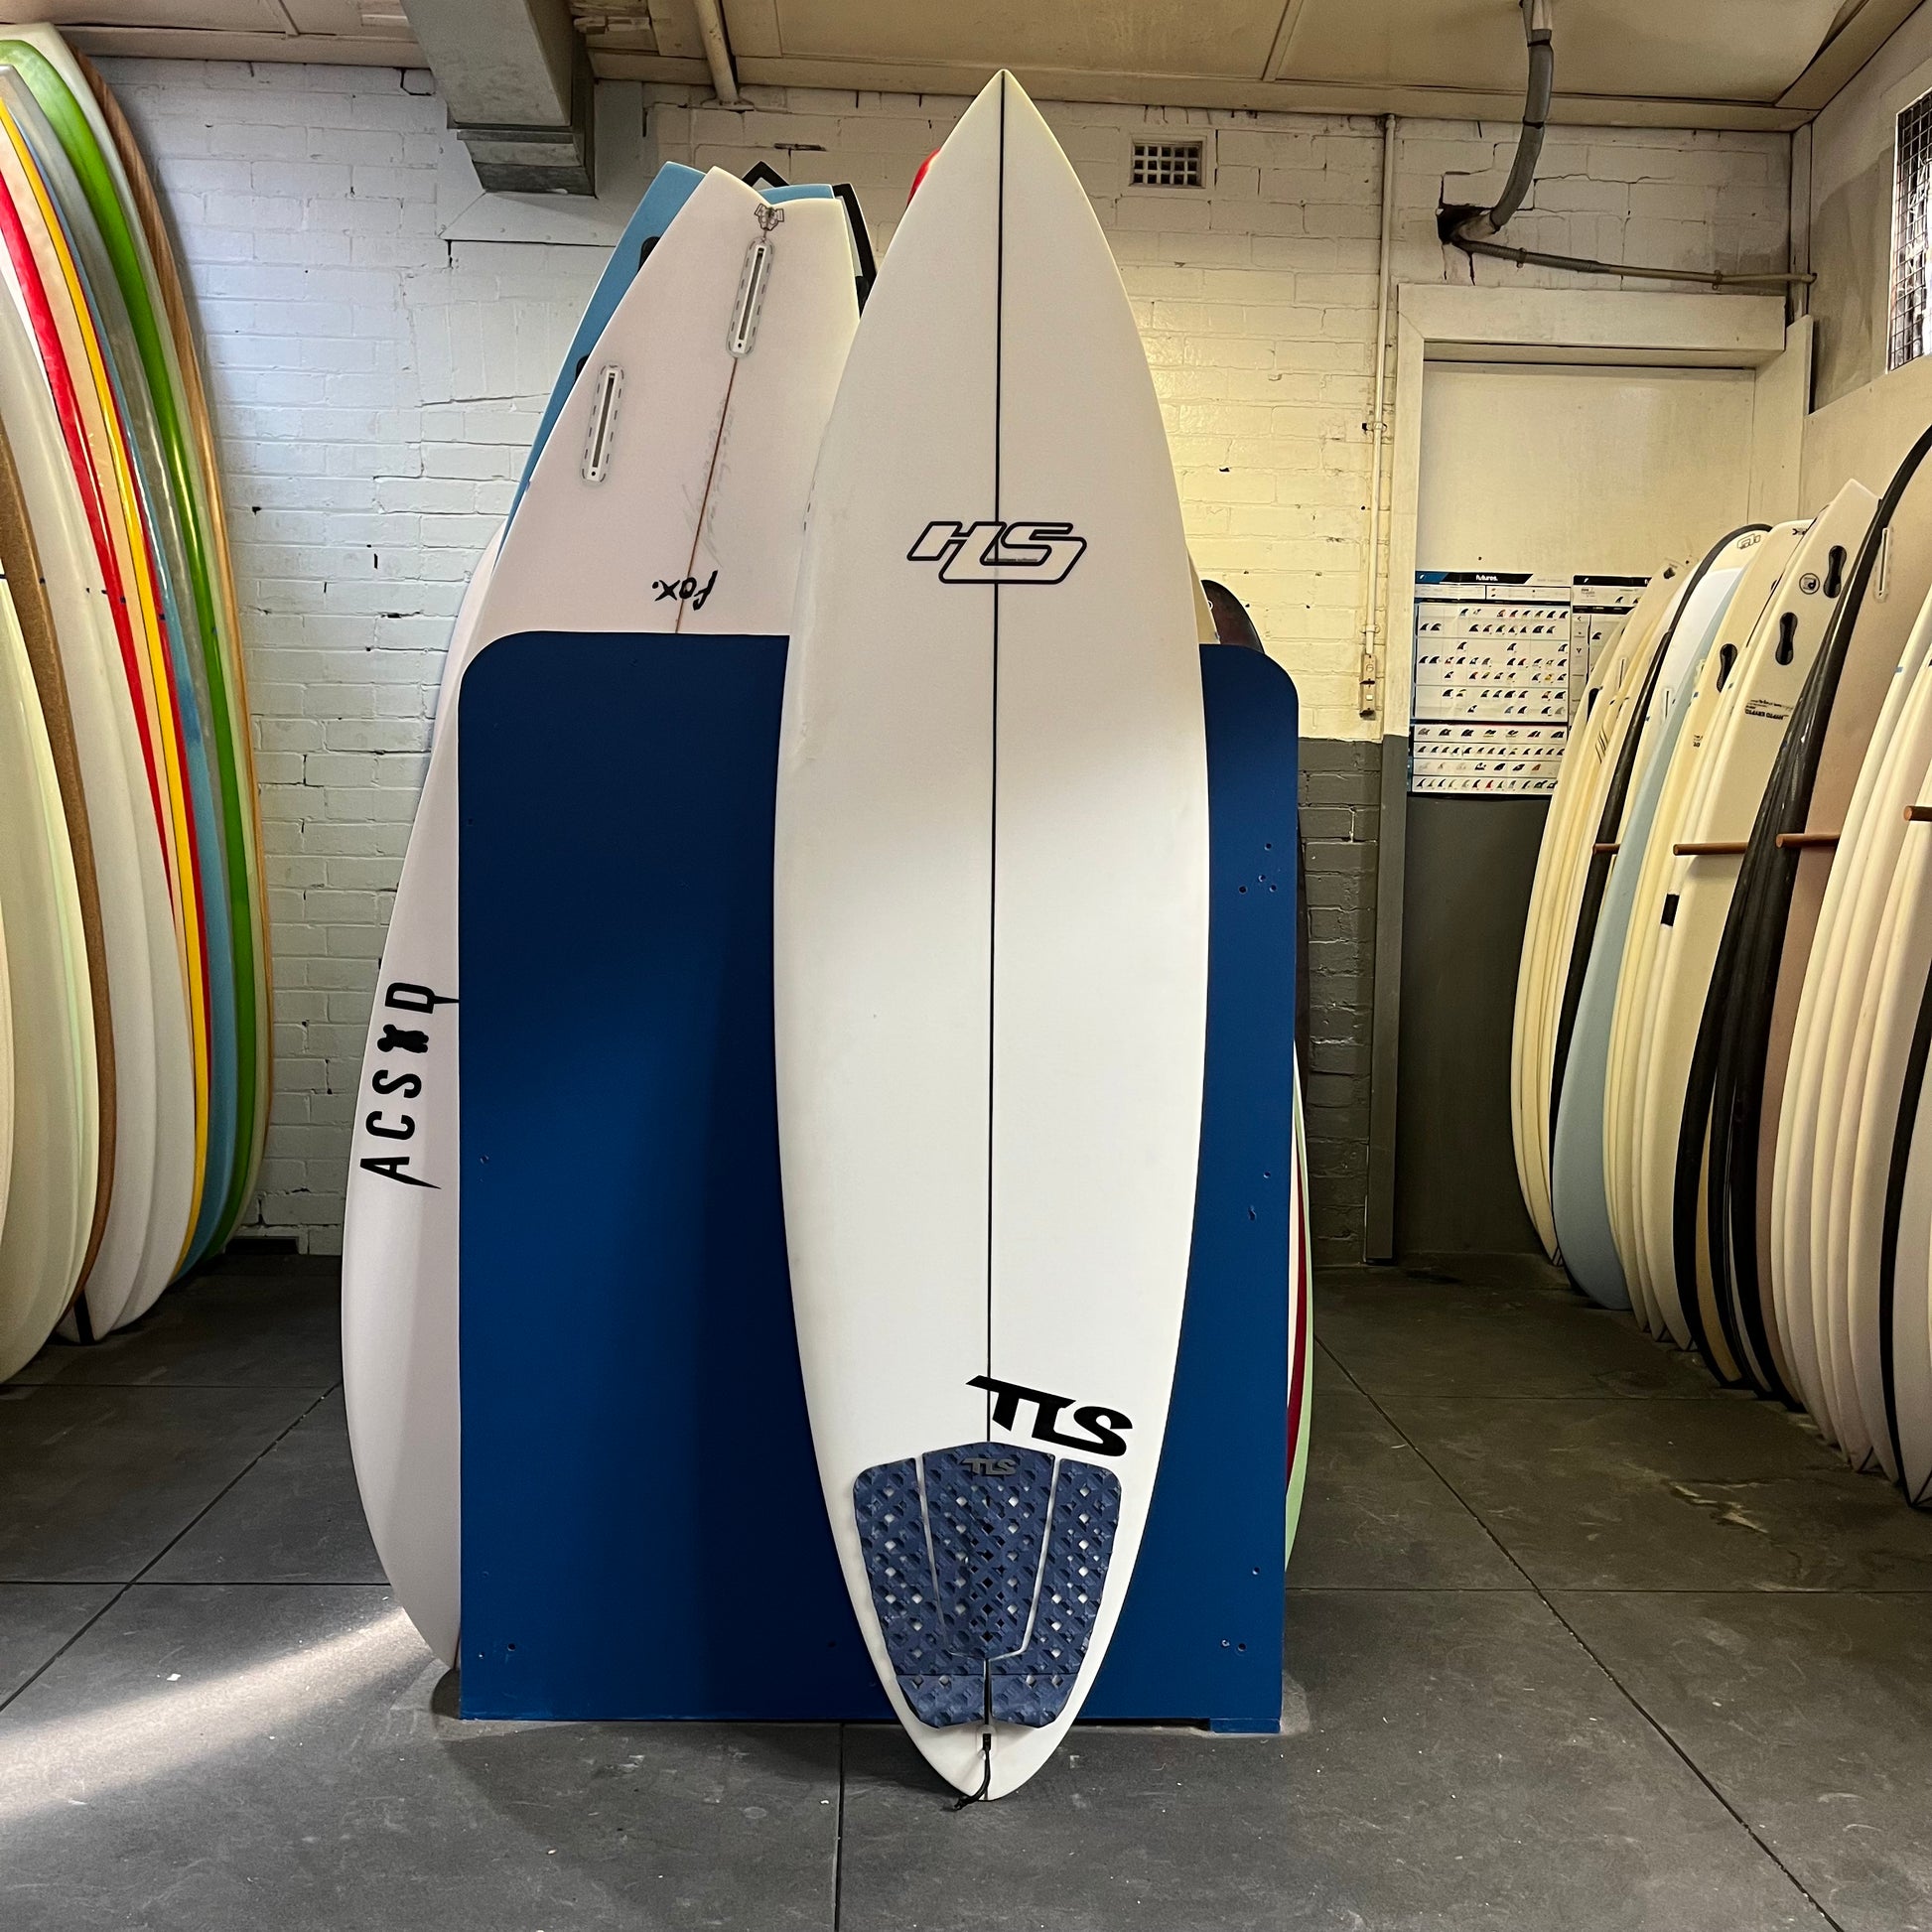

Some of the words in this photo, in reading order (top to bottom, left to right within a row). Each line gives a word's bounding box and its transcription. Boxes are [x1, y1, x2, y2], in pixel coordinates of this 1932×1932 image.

[905, 521, 1087, 585] HS
[965, 1374, 1134, 1457] TLS
[961, 1456, 1018, 1477] TLS
